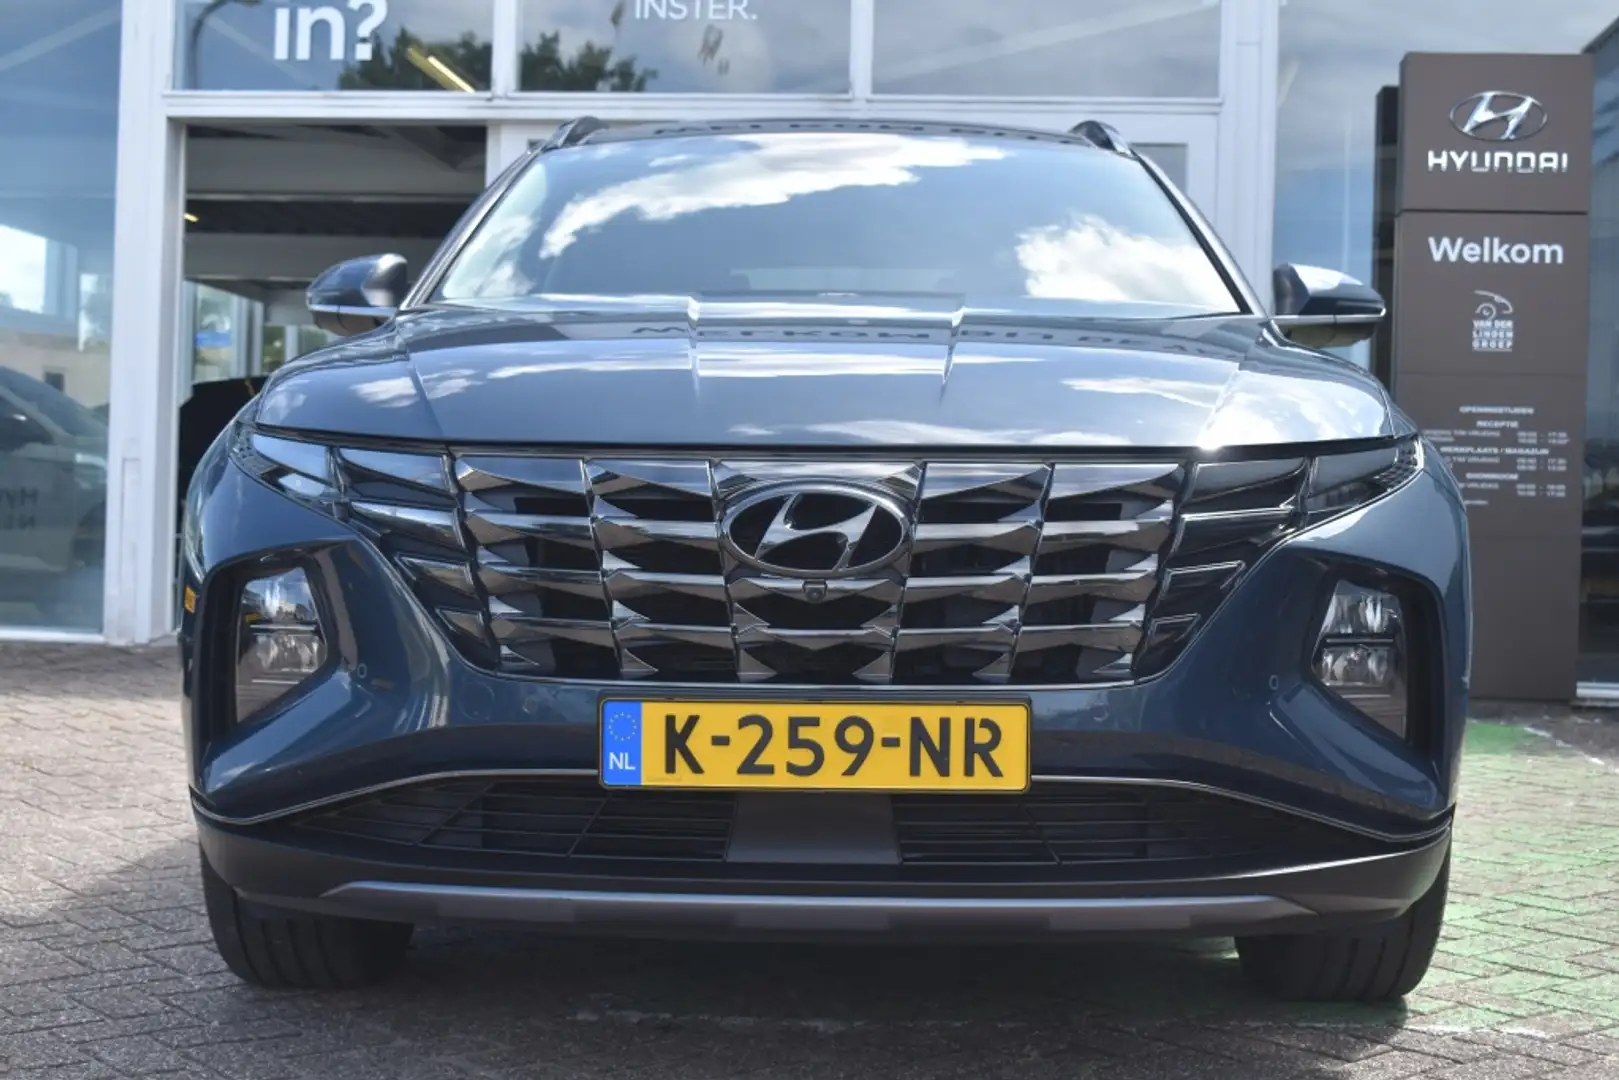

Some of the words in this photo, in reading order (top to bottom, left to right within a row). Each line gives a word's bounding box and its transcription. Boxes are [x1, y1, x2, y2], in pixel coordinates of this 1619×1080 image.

[274, 0, 387, 61] in?
[1427, 150, 1568, 173] HYUNDAI
[1427, 236, 1564, 264] Welkom
[664, 714, 1004, 778] K-259-NR
[608, 751, 637, 771] NL
